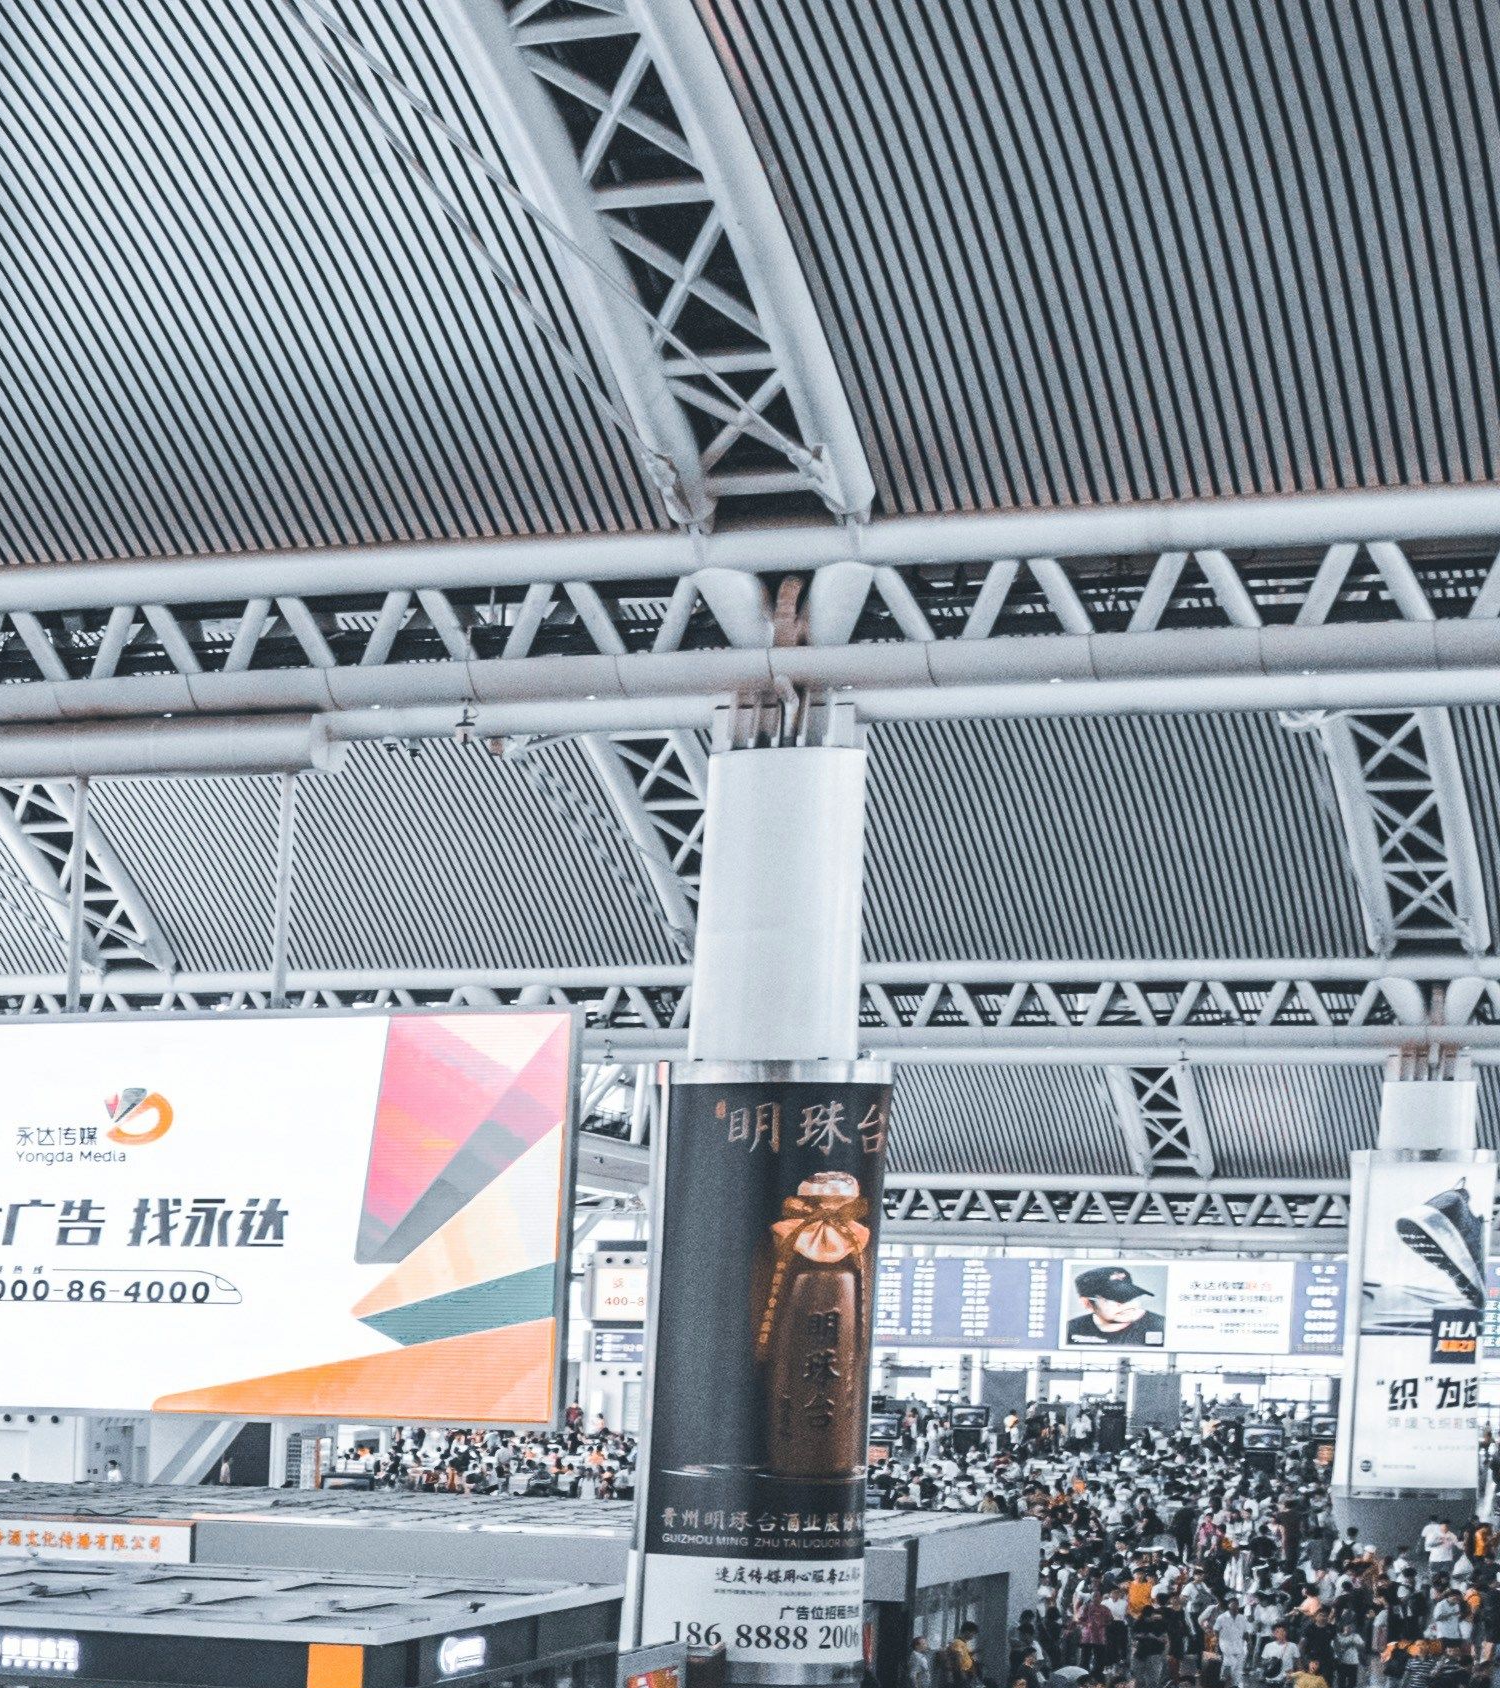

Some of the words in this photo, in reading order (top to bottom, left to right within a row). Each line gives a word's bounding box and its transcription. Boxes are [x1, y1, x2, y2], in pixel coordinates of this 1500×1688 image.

[16, 1127, 98, 1146] 永达传媒
[16, 1150, 73, 1166] Yongda
[80, 1150, 126, 1162] Media
[127, 1198, 289, 1248] 找永达
[1438, 1321, 1477, 1338] HLA
[662, 1533, 713, 1545] GUIZHOU
[716, 1536, 748, 1547] MING
[754, 1537, 779, 1548] ZHU
[673, 1621, 722, 1646] 186
[735, 1624, 807, 1650] 8888
[819, 1625, 860, 1648] 2006
